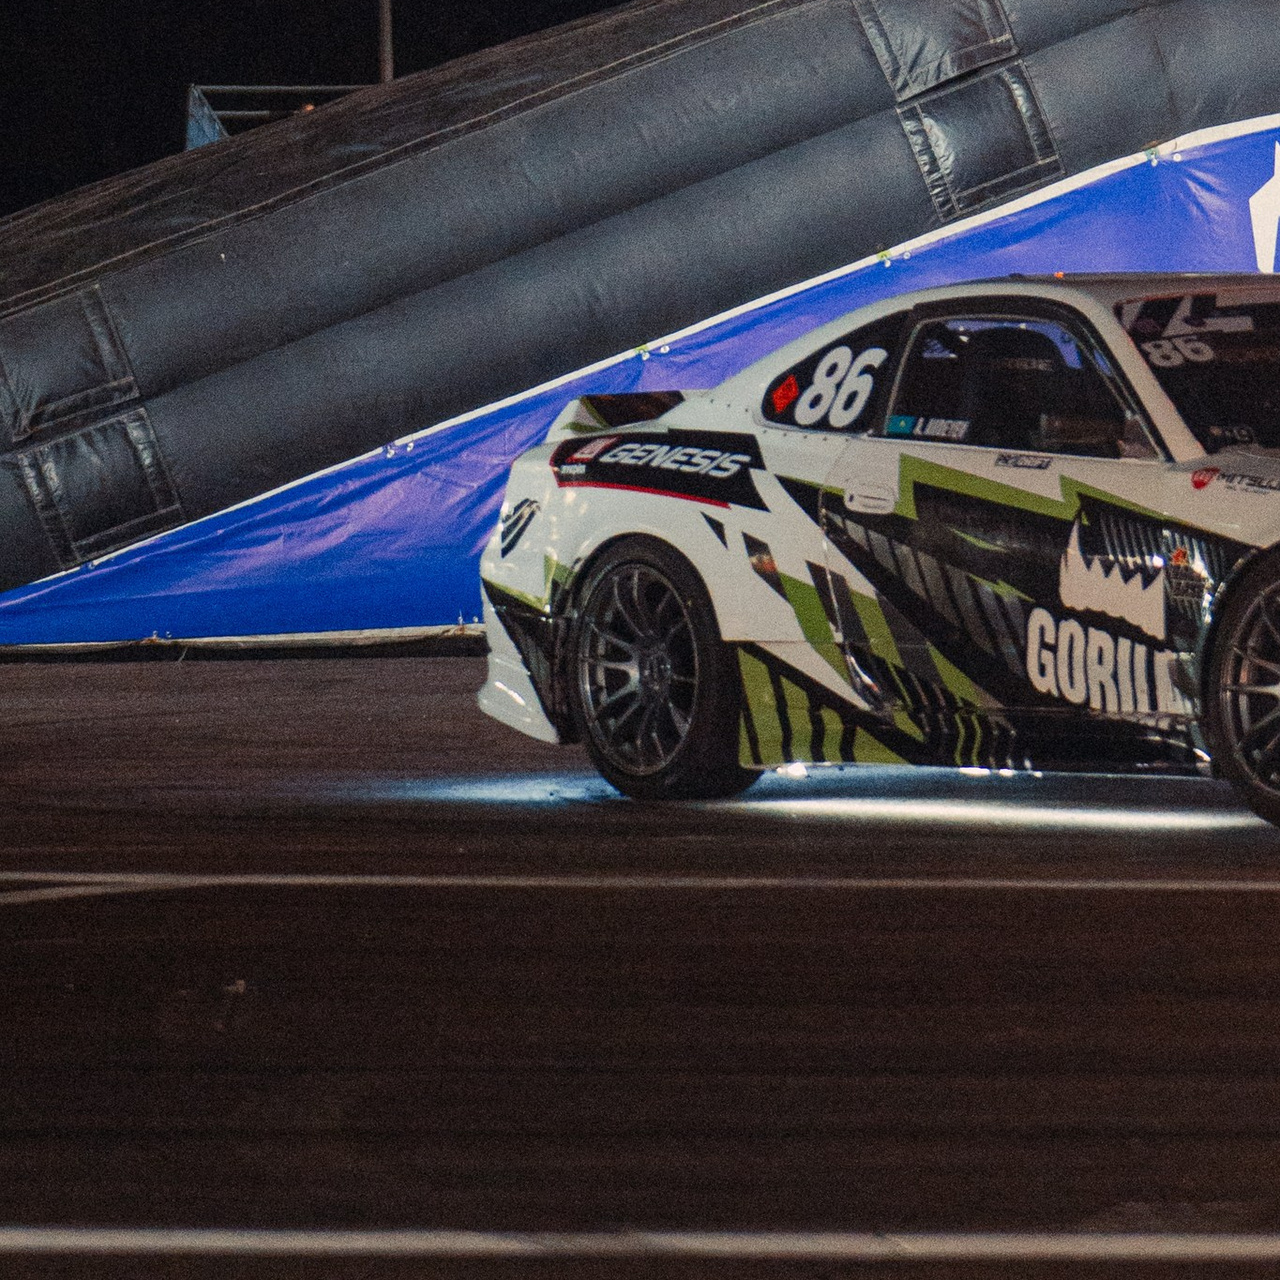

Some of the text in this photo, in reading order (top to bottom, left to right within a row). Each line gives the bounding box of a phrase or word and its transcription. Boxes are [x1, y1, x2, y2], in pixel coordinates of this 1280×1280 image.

[1141, 335, 1214, 368] 86
[794, 345, 888, 428] 86
[600, 443, 750, 479] GENESIS
